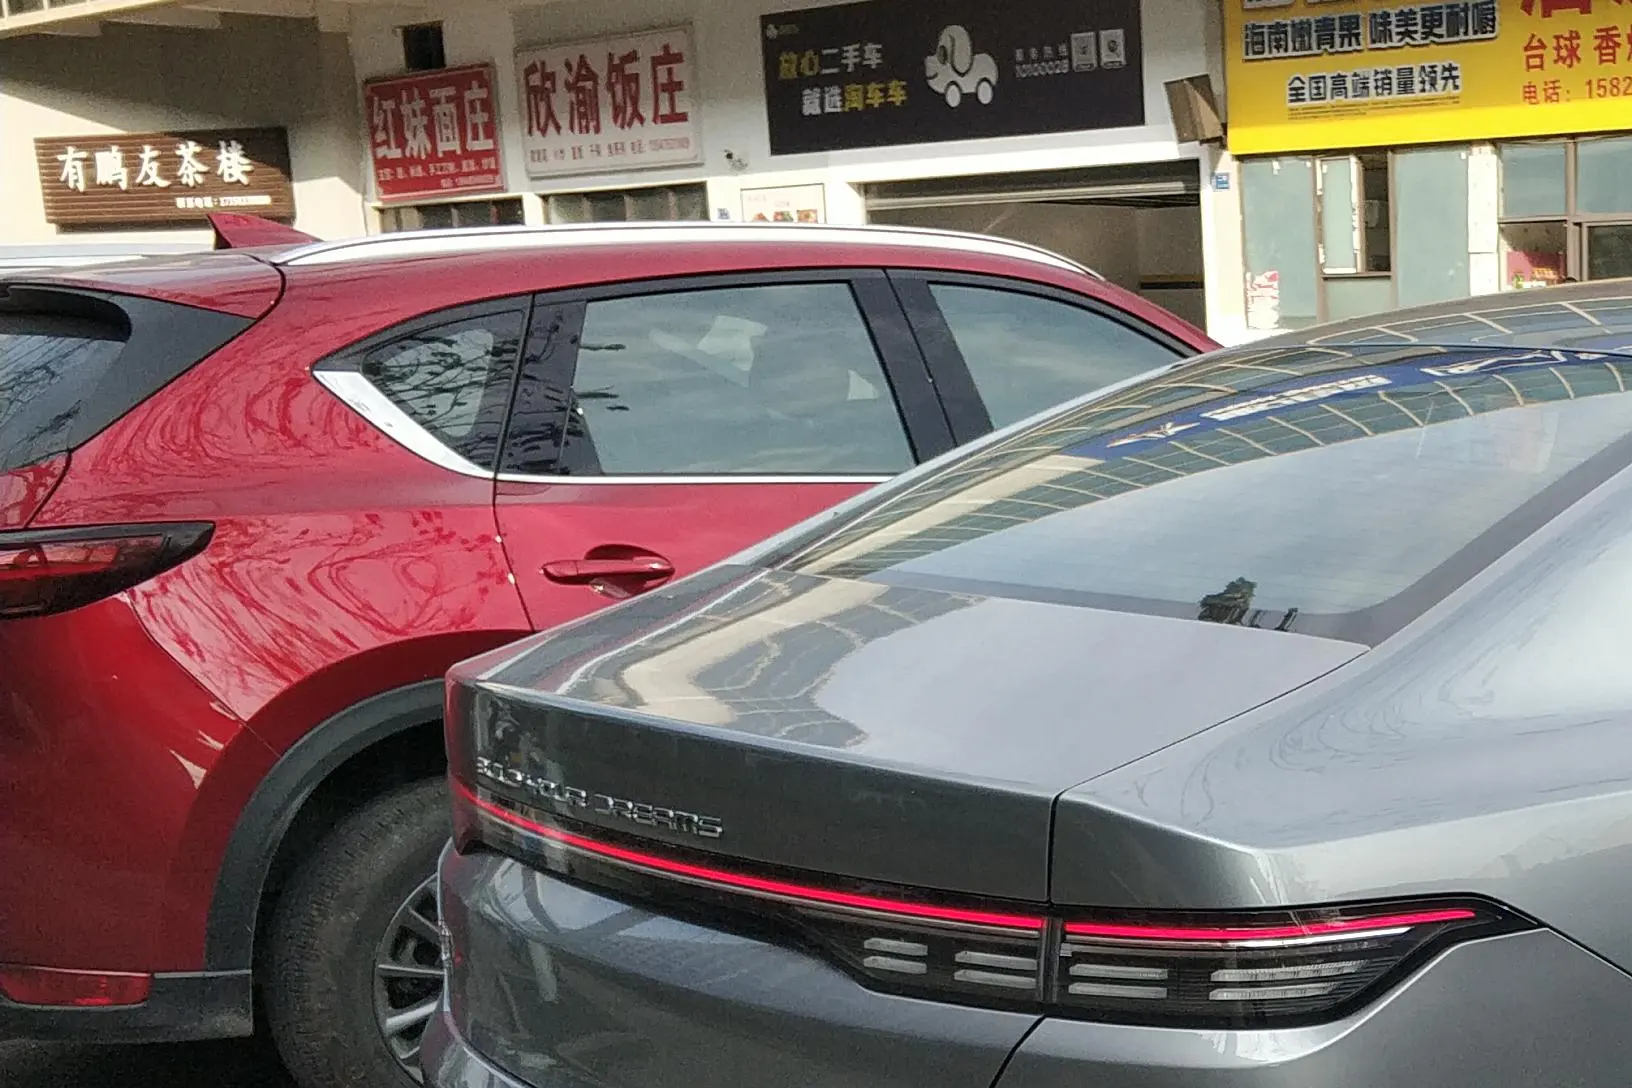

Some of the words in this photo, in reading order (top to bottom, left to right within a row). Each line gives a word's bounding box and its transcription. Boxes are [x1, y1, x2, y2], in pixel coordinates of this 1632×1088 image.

[1523, 30, 1582, 72] 台球
[523, 43, 689, 138] 欣渝饭庄
[1287, 62, 1461, 104] 全国高端销量领先
[593, 793, 723, 839] DREAMS
